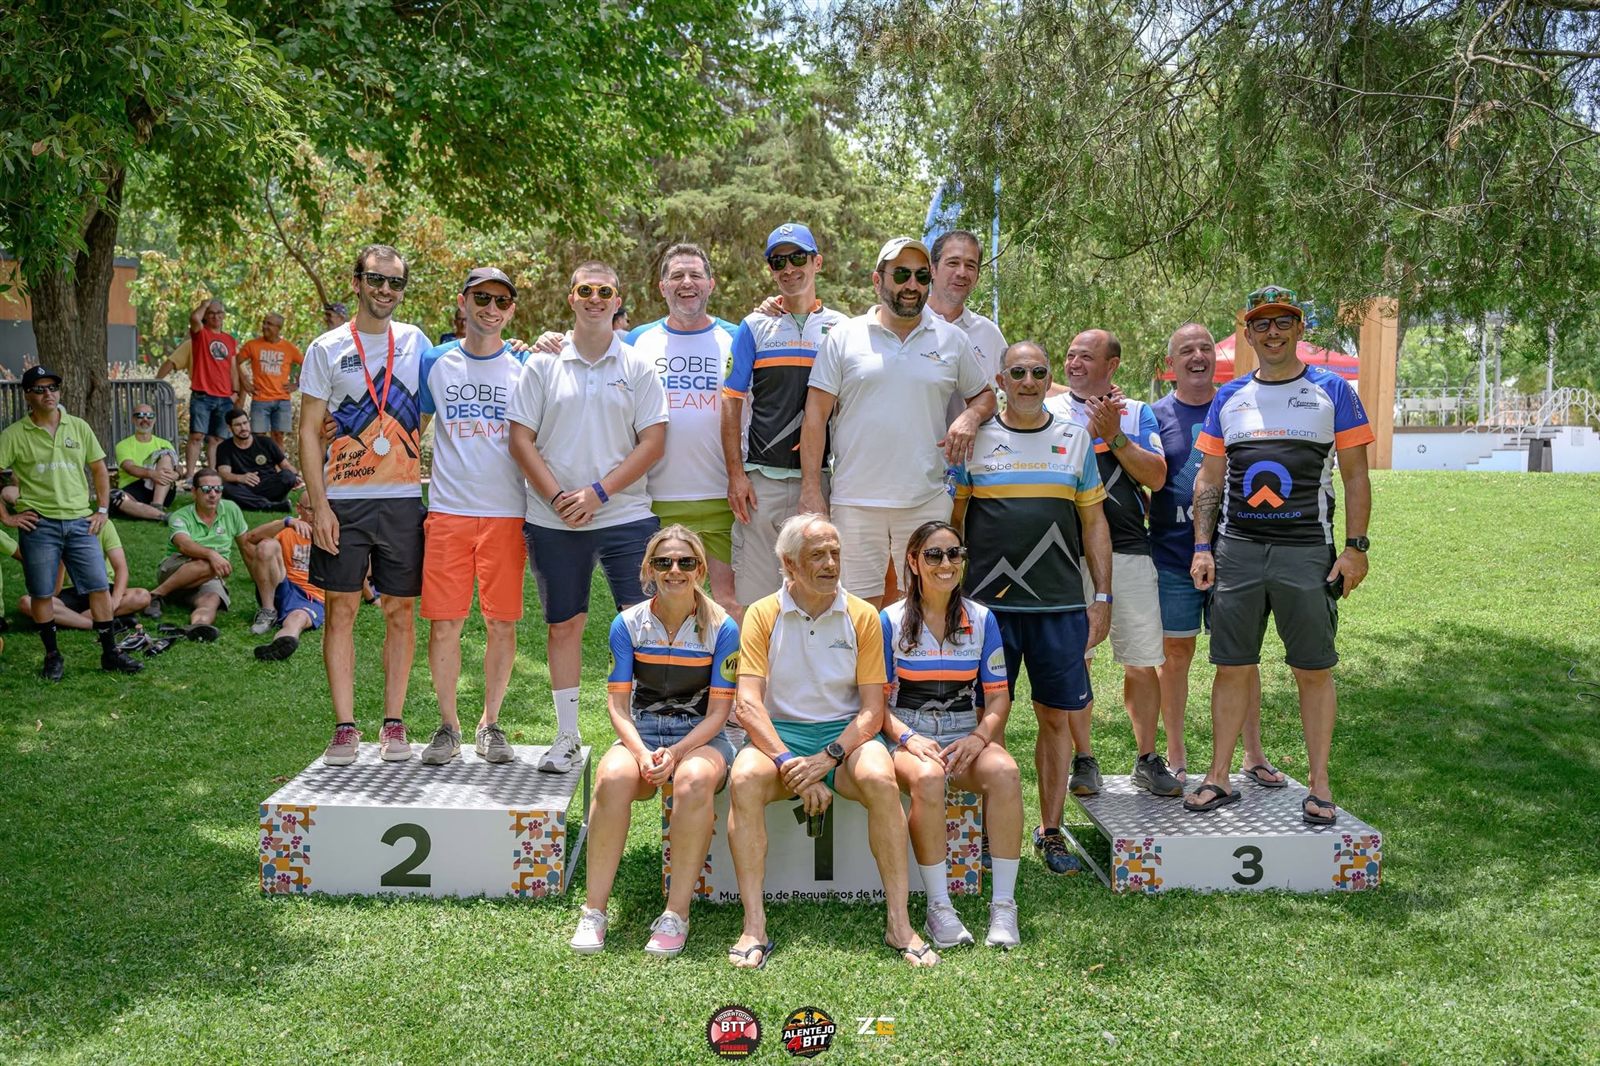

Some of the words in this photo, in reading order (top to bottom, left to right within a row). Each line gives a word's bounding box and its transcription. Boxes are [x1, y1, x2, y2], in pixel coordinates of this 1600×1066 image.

[445, 383, 507, 404] SOBE
[666, 392, 716, 411] EAM
[446, 403, 506, 421] DESCE
[445, 420, 505, 439] TEAM
[792, 794, 834, 881] 1
[380, 823, 431, 887] 2
[1232, 845, 1264, 886] 3
[775, 889, 790, 900] de
[856, 889, 871, 900] de
